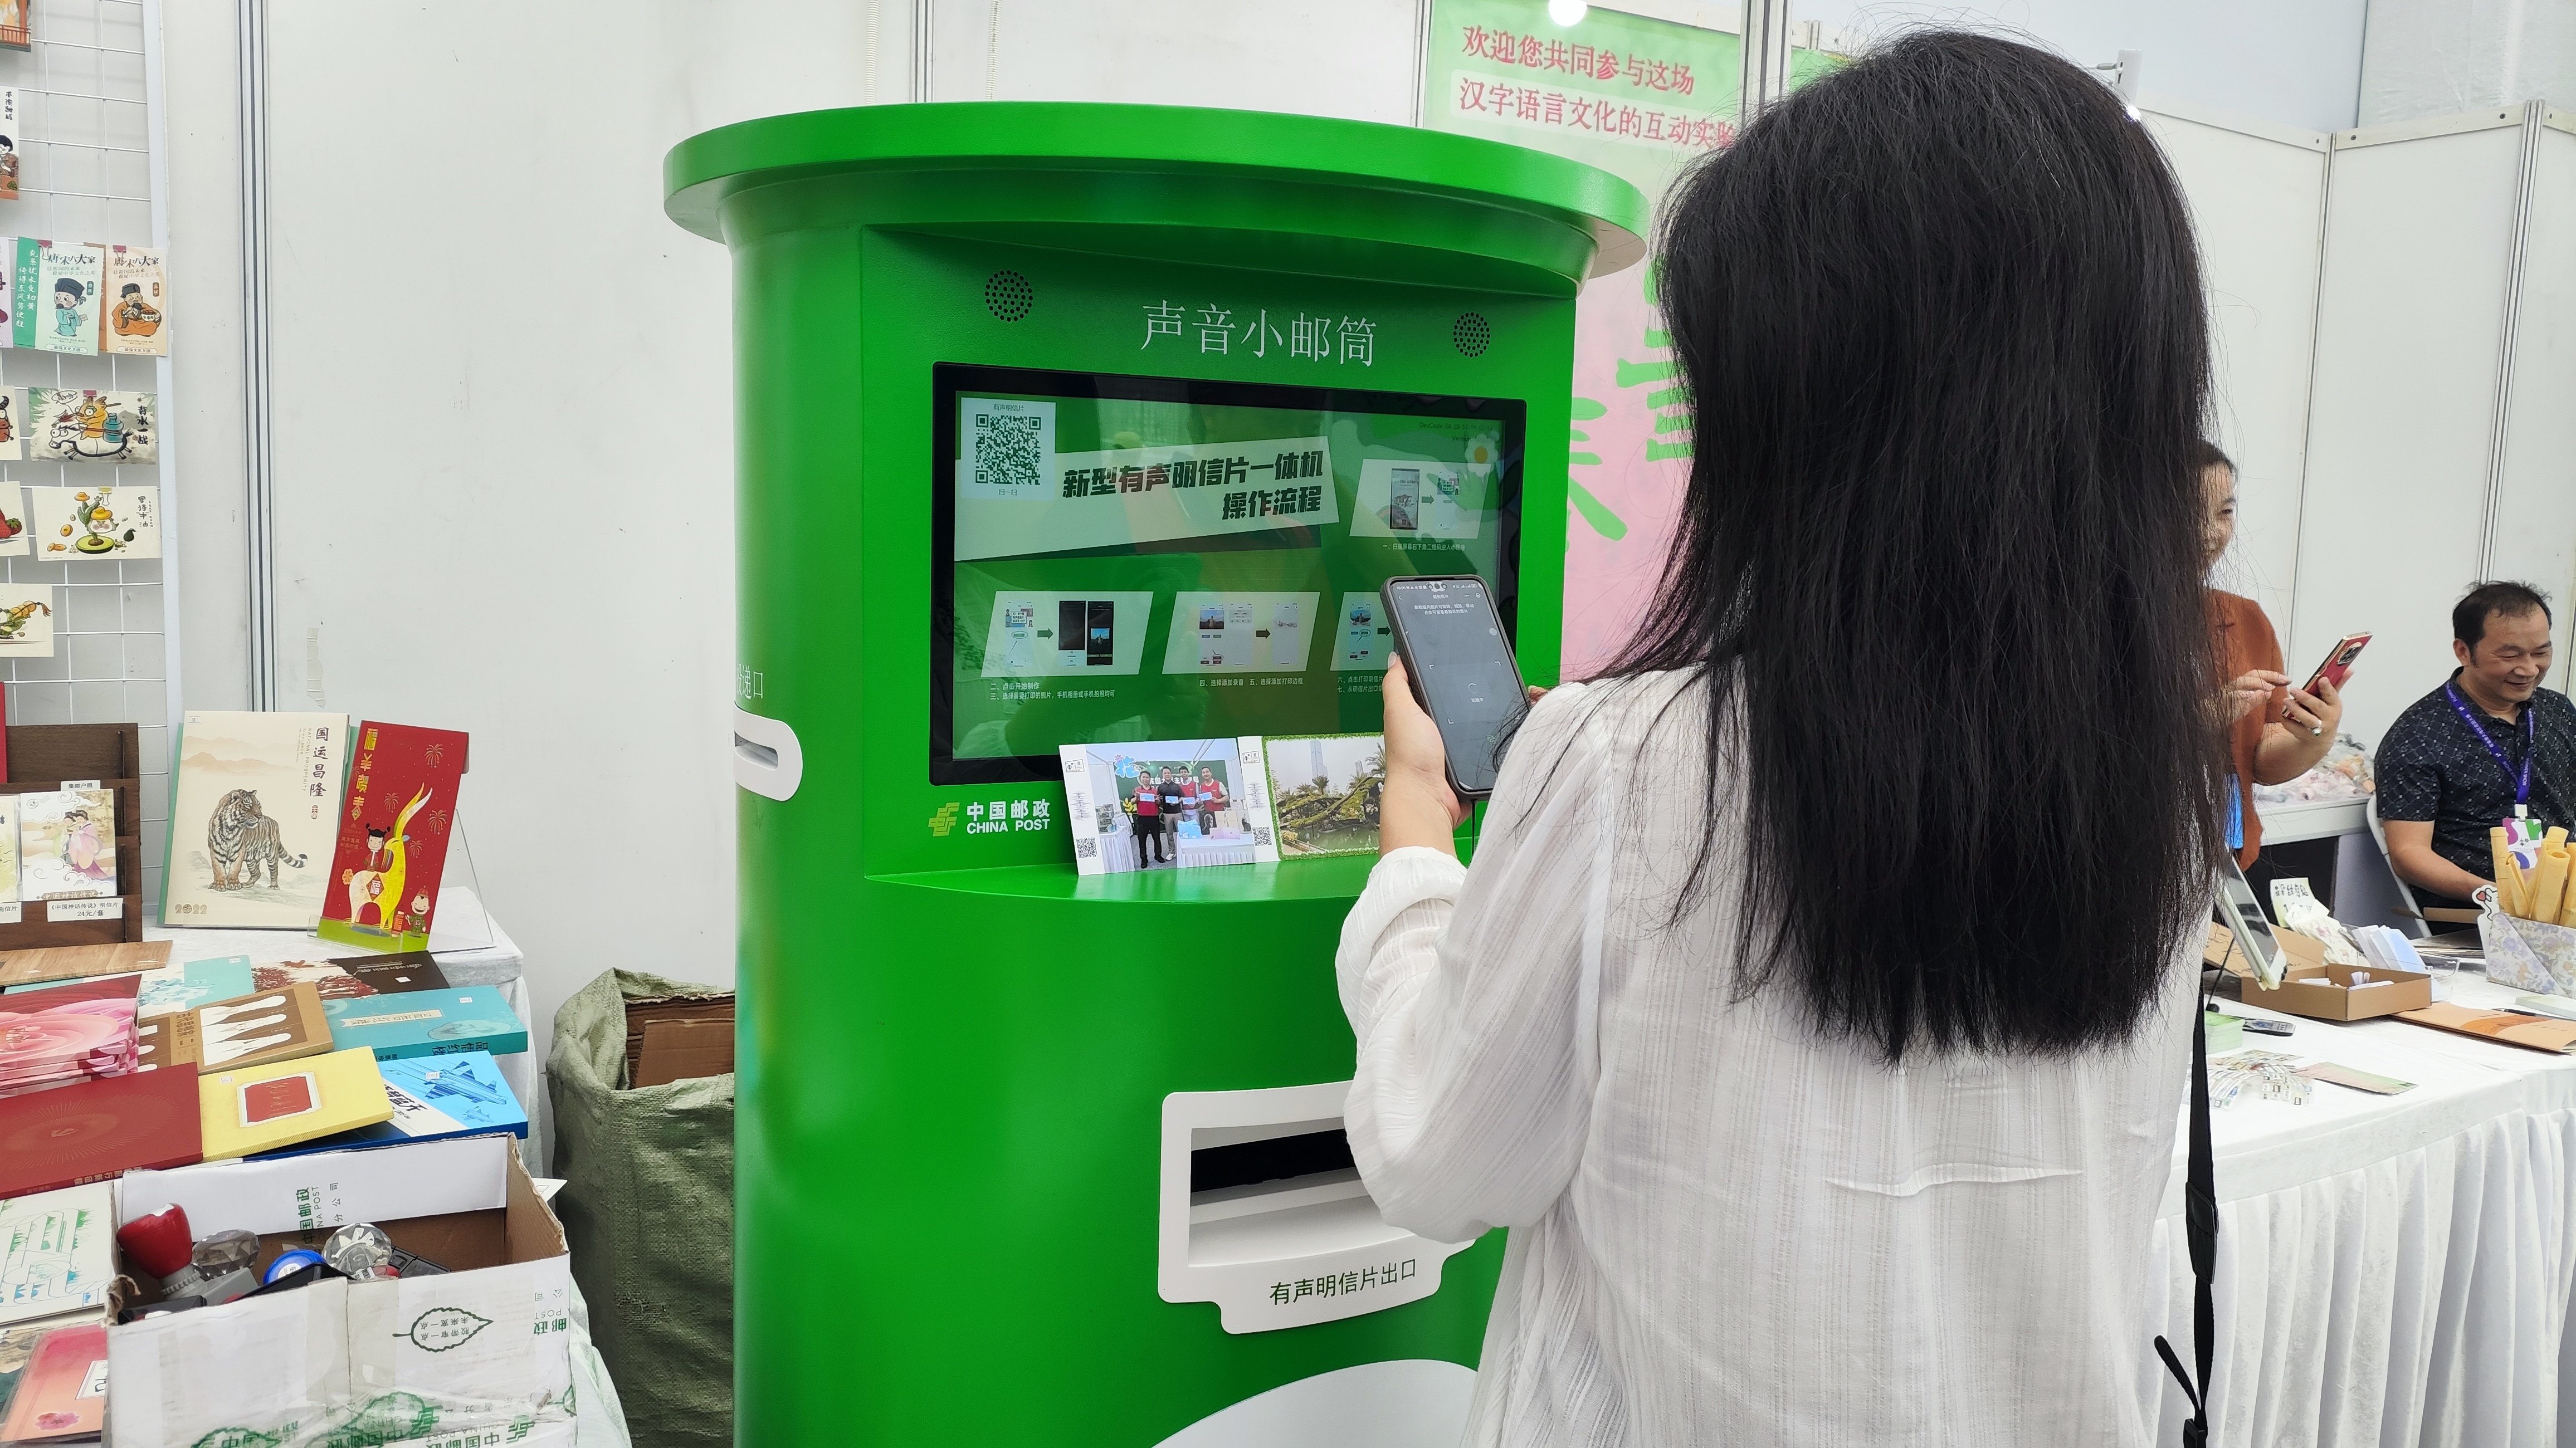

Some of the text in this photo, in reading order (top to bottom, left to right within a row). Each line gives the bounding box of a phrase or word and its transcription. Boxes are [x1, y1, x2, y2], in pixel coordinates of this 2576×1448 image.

[1461, 25, 1695, 96] 欢迎您共同参与这场
[48, 253, 96, 265] 唐宋八大家
[114, 256, 159, 268] 唐宋八大家
[1141, 299, 1377, 366] 声音小邮筒
[993, 403, 1024, 412] 有声明信片
[138, 405, 149, 445] 背水一战
[1062, 451, 1324, 498] 新型有声明信片一体机
[998, 488, 1017, 497] 扫一扫
[1222, 485, 1322, 520] 操作流程
[990, 682, 1040, 691] 二、点击开始制作
[310, 727, 329, 797] 国运昌隆
[967, 798, 1050, 821] 中国邮政
[967, 819, 1050, 834] CHINA POST
[370, 880, 380, 894] 福
[311, 1186, 321, 1210] POST
[330, 1182, 343, 1222] 分公司
[1269, 1259, 1416, 1305] 有声明信片出口
[420, 1317, 469, 1330] 未来宽一点
[534, 1309, 562, 1320] POST
[420, 1327, 469, 1341] 胶带窄一点
[533, 1318, 567, 1336] 邮政
